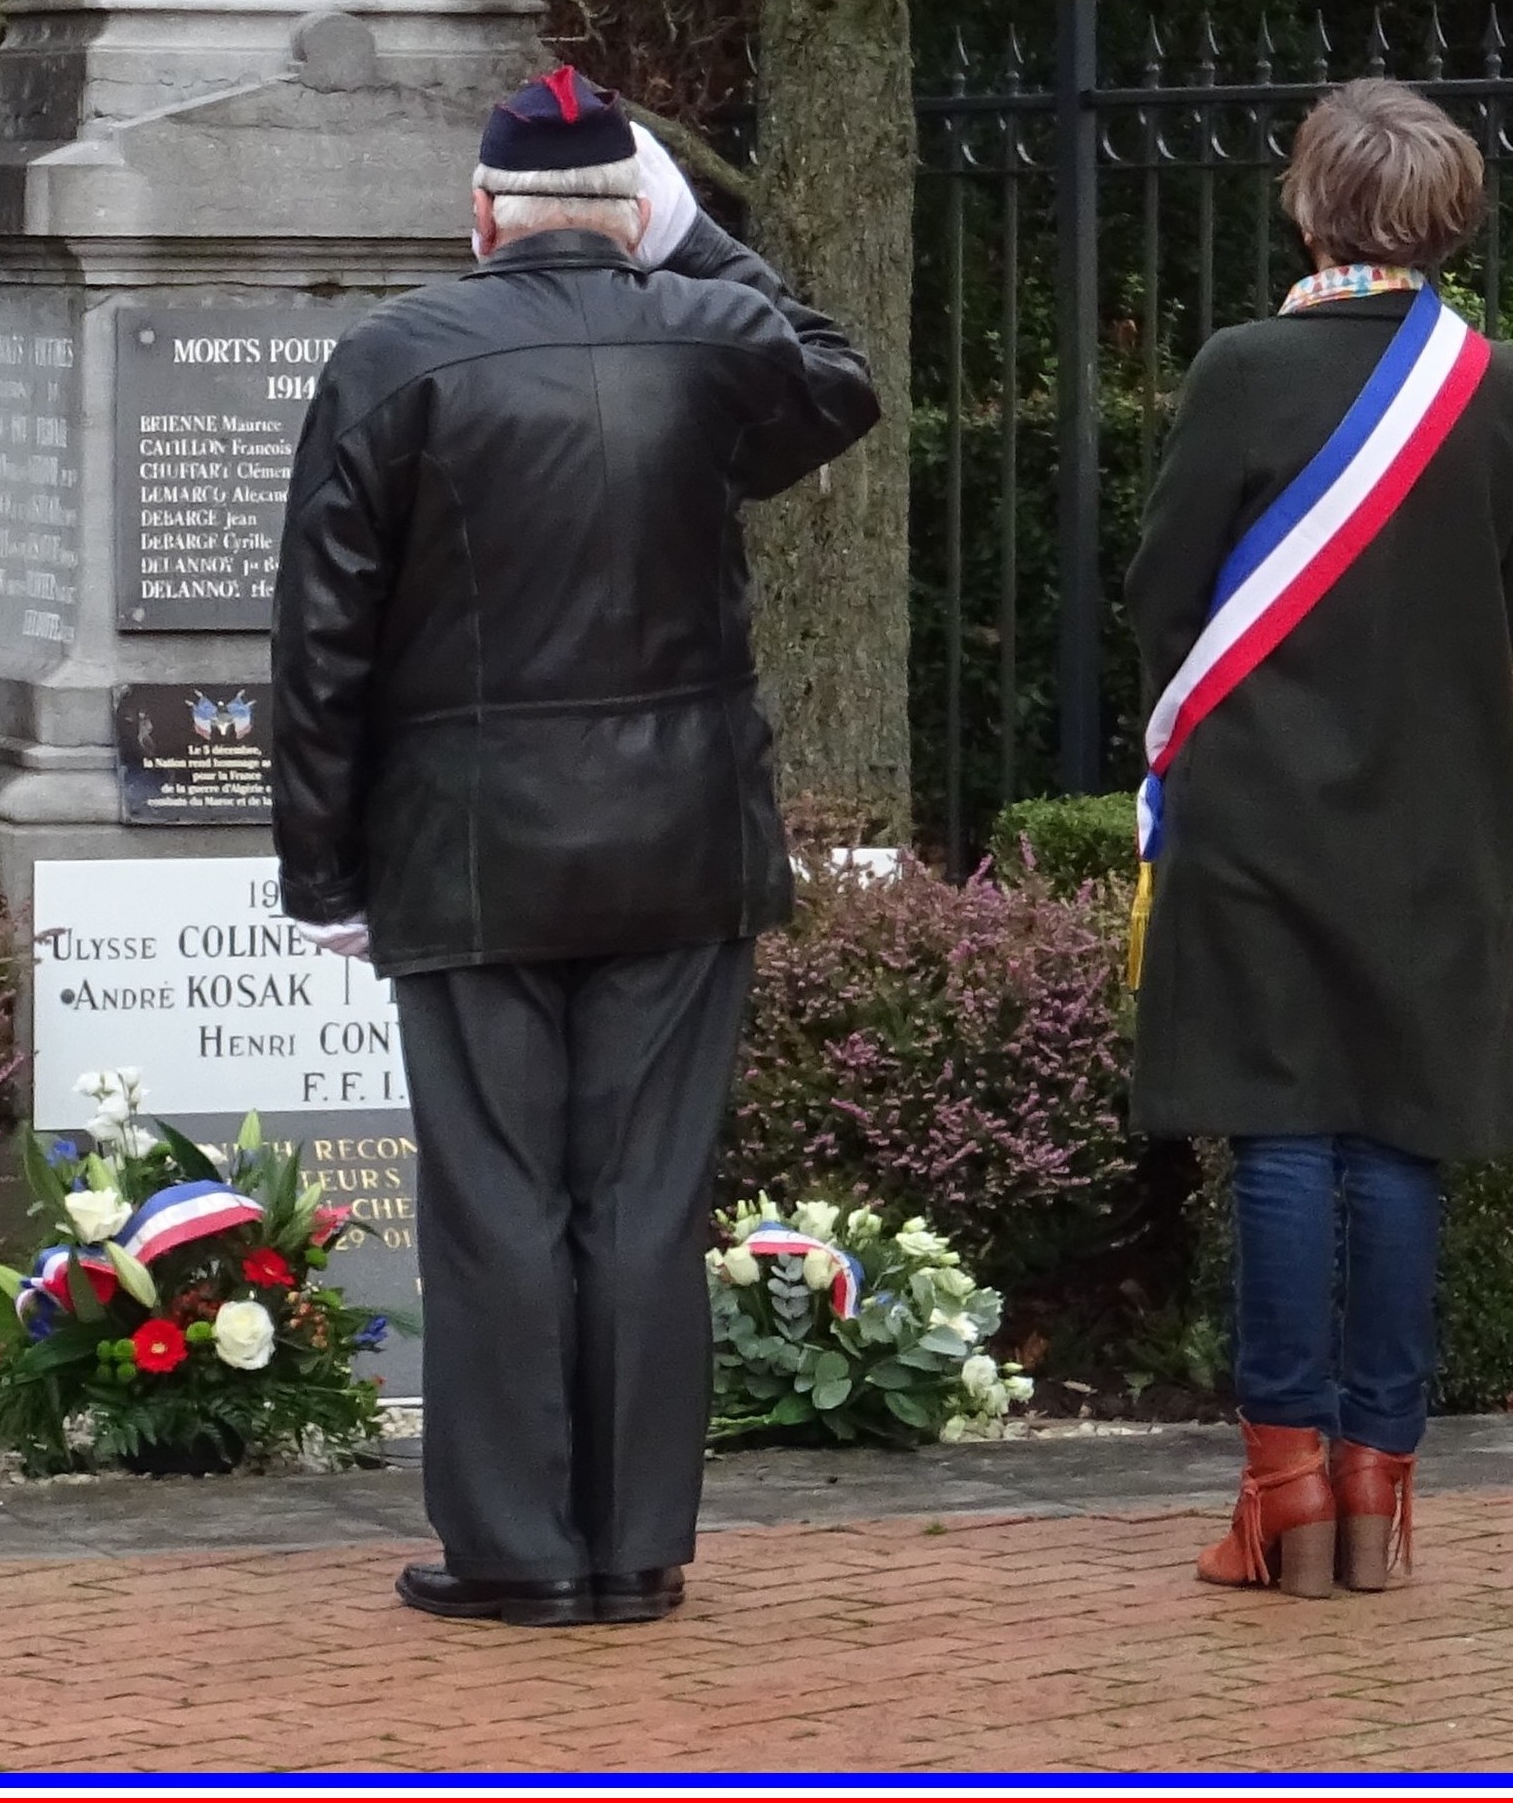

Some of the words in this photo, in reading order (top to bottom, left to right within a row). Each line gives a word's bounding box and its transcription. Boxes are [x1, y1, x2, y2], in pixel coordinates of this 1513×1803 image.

[173, 338, 261, 364] MORTS
[140, 415, 218, 433] BRIENNE
[222, 415, 282, 433] Maurice
[237, 461, 292, 480] Clémen
[141, 509, 221, 527] DEBARGE
[223, 532, 273, 554] Cyrille
[52, 927, 158, 962] ULYSSE
[178, 924, 323, 960] COLINE
[186, 972, 313, 1009] KOSAK
[199, 1025, 297, 1059] HENRI
[319, 1021, 399, 1056] CON
[314, 1137, 419, 1162] RECON
[298, 1167, 402, 1193] TEURS
[352, 1197, 416, 1221] CHE
